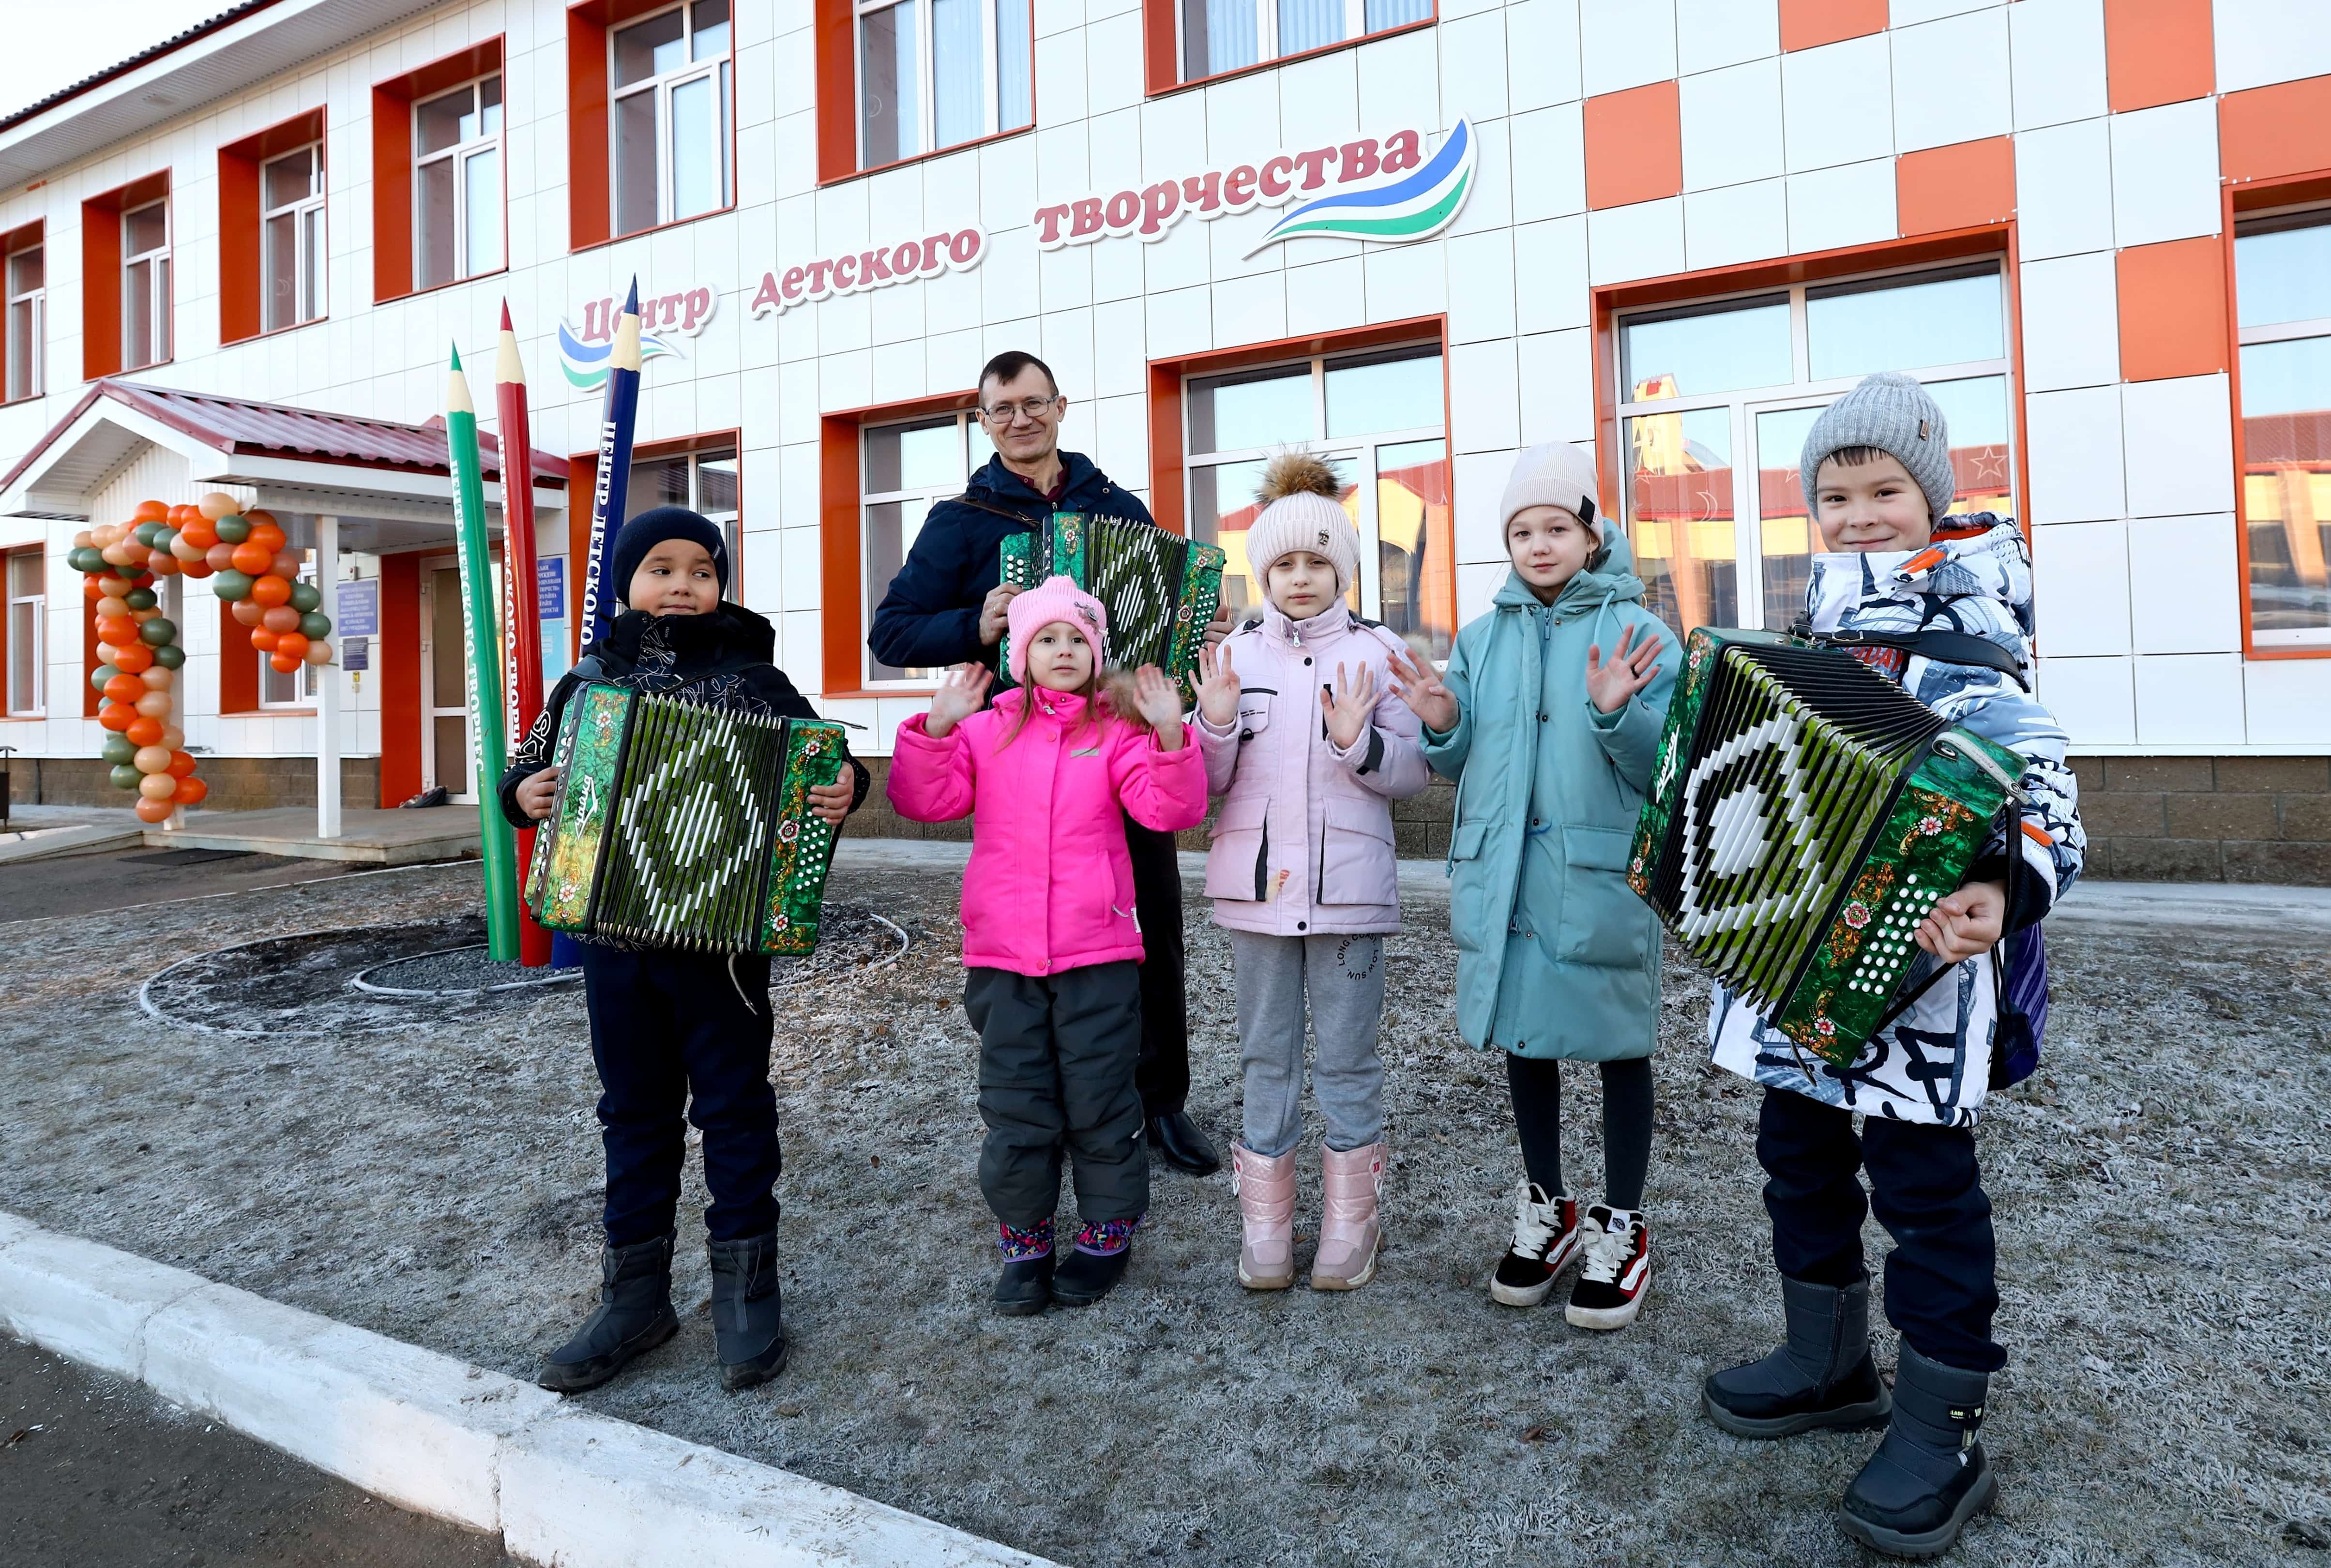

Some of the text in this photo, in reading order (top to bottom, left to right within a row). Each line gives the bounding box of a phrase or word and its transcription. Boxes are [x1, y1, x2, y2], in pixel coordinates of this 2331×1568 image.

[751, 228, 981, 312] детского
[1034, 129, 1422, 243] творчества
[457, 540, 475, 657] ДЕТСКОГО
[580, 421, 617, 646] ЦЕНТР ДЕТСКОГО
[1336, 939, 1351, 966] LONG
[1368, 950, 1379, 972] LOW
